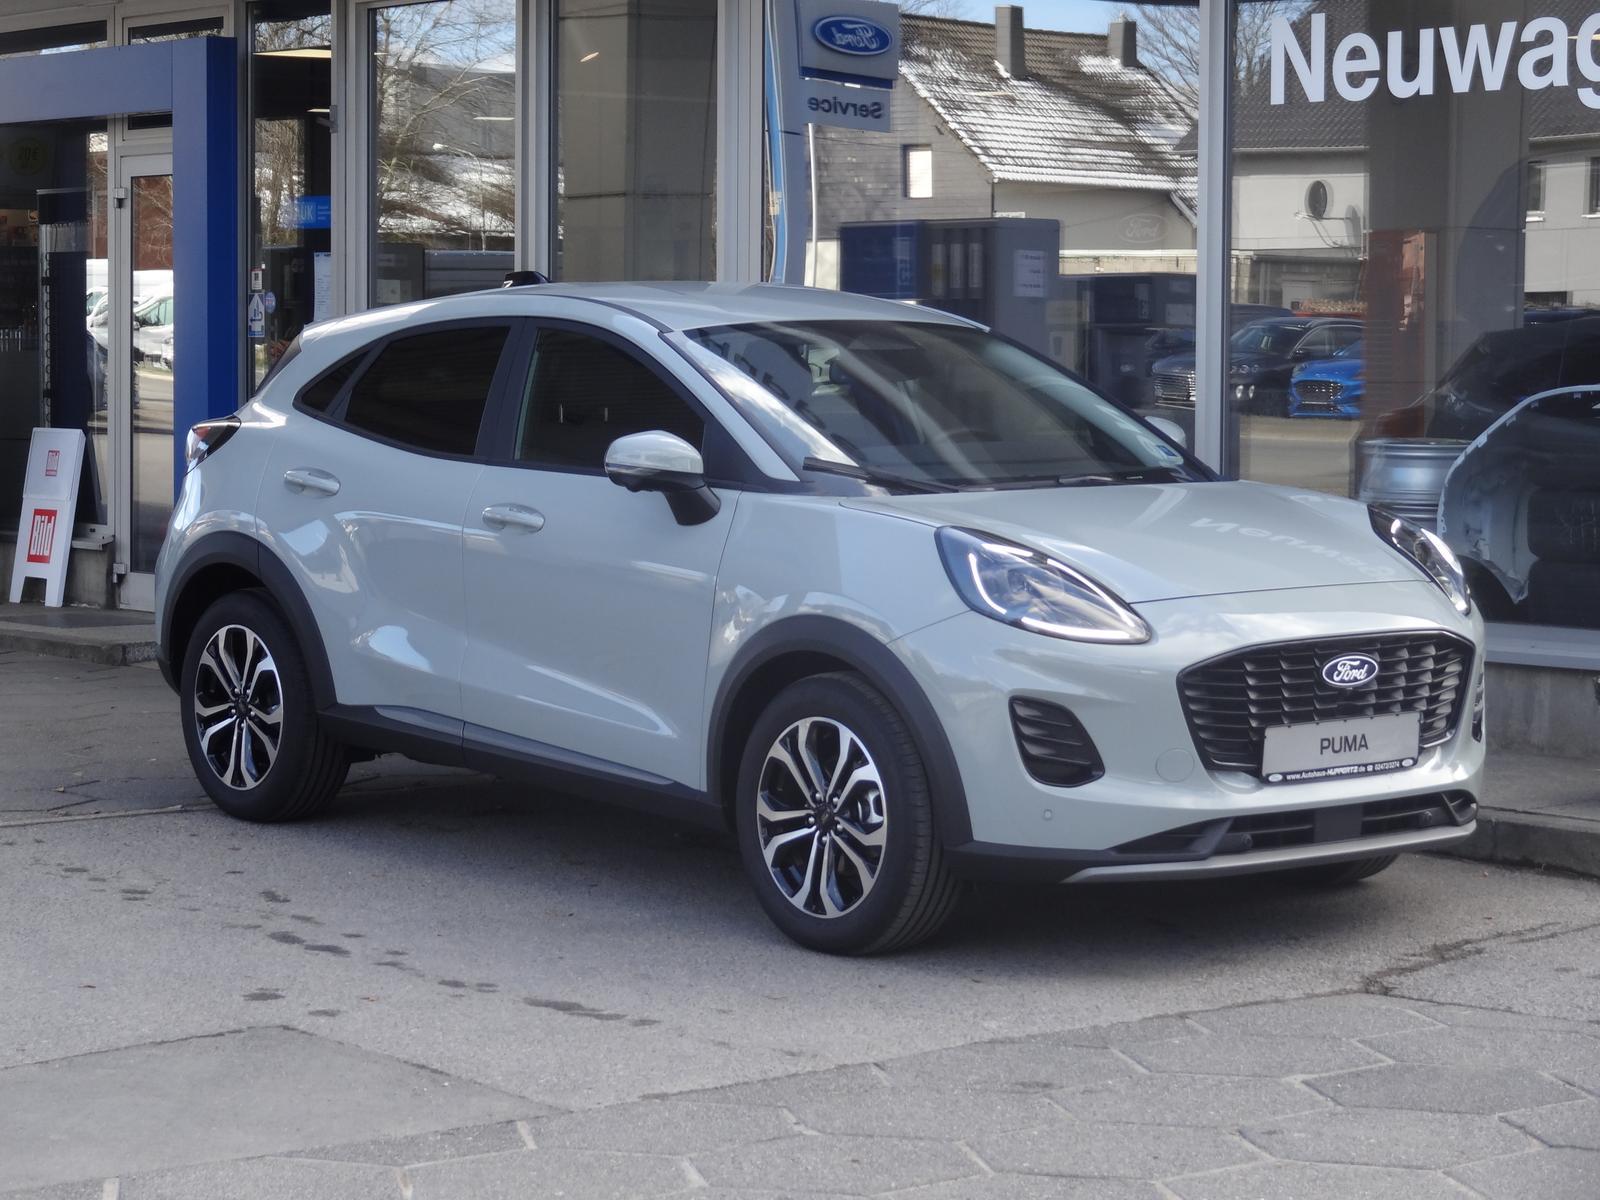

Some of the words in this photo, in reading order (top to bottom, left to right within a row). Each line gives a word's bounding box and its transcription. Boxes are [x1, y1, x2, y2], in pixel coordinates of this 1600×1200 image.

[1125, 218, 1161, 238] Ford
[30, 515, 55, 556] Bild
[1333, 660, 1368, 681] Ford
[1320, 733, 1368, 755] PUMA
